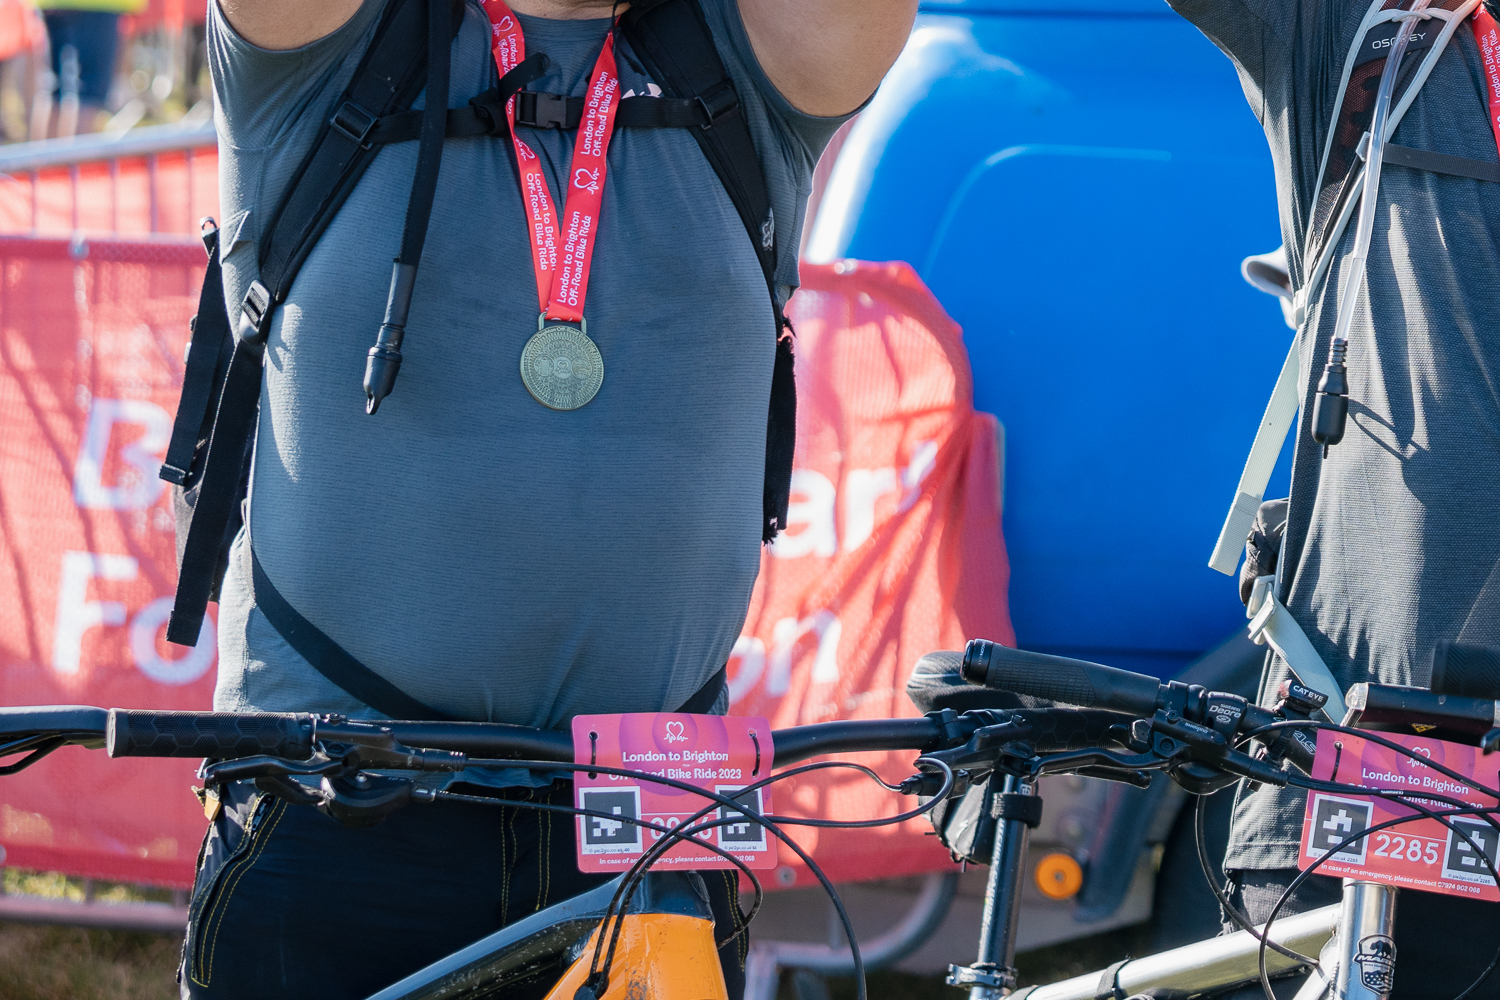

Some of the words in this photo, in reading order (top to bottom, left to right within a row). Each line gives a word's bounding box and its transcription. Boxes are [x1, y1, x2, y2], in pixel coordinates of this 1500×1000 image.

[1489, 28, 1499, 47] Ride
[1481, 34, 1495, 66] Brighton
[1488, 64, 1496, 74] to
[588, 71, 609, 109] Brighton
[586, 108, 596, 119] to
[598, 94, 612, 113] Bike
[580, 120, 594, 155] London
[592, 114, 608, 157] Off-Road
[526, 172, 542, 221] Off-Road
[534, 173, 549, 211] London
[543, 212, 551, 224] to
[534, 222, 544, 246] Bike
[564, 210, 580, 253] Brighton
[578, 214, 592, 237] Ride
[538, 247, 550, 271] Ride
[564, 254, 573, 265] to
[576, 238, 588, 260] Bike
[556, 266, 571, 304] London
[568, 260, 584, 306] Off-Road
[1293, 684, 1324, 702] CATEYE
[1209, 704, 1242, 718] Deore
[622, 750, 667, 762] London
[668, 750, 682, 762] to
[683, 750, 730, 763] Brighton
[667, 768, 692, 780] Bike
[694, 768, 718, 779] Ride
[718, 768, 742, 780] 2023
[1362, 768, 1406, 784] London
[1407, 774, 1421, 786] to
[1422, 776, 1470, 795] Brighton
[674, 856, 694, 864] please
[1374, 834, 1440, 865] 2285
[1359, 870, 1394, 882] emergency,
[1394, 874, 1414, 884] please
[1414, 878, 1438, 887] contact
